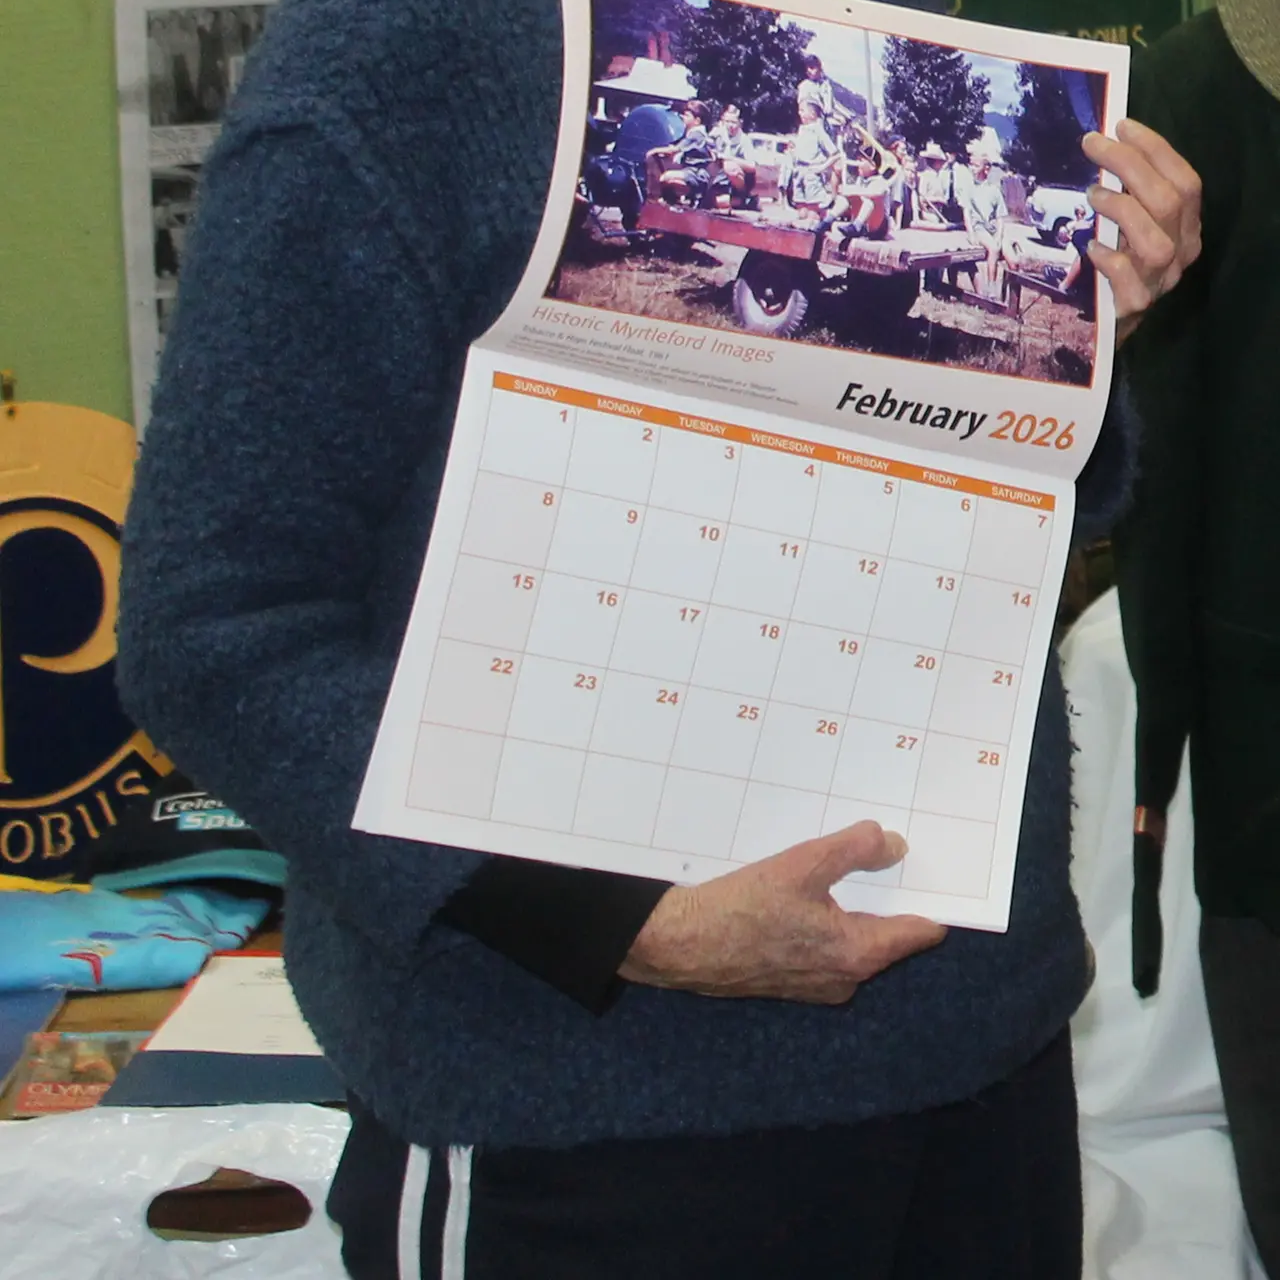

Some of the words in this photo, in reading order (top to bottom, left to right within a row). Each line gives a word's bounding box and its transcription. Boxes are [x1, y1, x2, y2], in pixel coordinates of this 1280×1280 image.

[532, 305, 602, 332] Historic
[610, 320, 707, 352] Myrtleford
[711, 338, 776, 364] Images
[514, 379, 558, 398] SUNDAY
[597, 398, 643, 417] MONDAY
[678, 416, 727, 435] TUESDAY
[751, 432, 815, 456] WEDNESDAY
[835, 451, 889, 472] THURSDAY
[922, 471, 958, 487] FRIDAY
[991, 486, 1042, 506] SATURDAY
[559, 409, 568, 424] 1
[642, 427, 653, 442] 2
[724, 445, 735, 460] 3
[804, 464, 815, 479] 4
[883, 480, 893, 495] 5
[961, 498, 971, 513] 6
[1038, 515, 1047, 529] 7
[836, 382, 988, 441] February
[988, 410, 1076, 451] 2026
[543, 491, 554, 507] 8
[627, 509, 638, 524] 9
[699, 525, 720, 542] 10
[780, 542, 799, 558] 11
[858, 558, 878, 575] 12
[936, 575, 955, 593] 13
[1012, 592, 1032, 608] 14
[512, 573, 534, 591] 15
[596, 591, 617, 608] 16
[678, 606, 700, 623] 17
[760, 623, 780, 640] 18
[838, 639, 858, 656] 19
[915, 654, 936, 671] 20
[993, 670, 1013, 687] 21
[491, 657, 513, 675] 22
[575, 674, 597, 691] 23
[657, 689, 678, 706] 24
[738, 704, 759, 721] 25
[816, 719, 837, 736] 26
[897, 734, 917, 751] 27
[977, 749, 999, 766] 28
